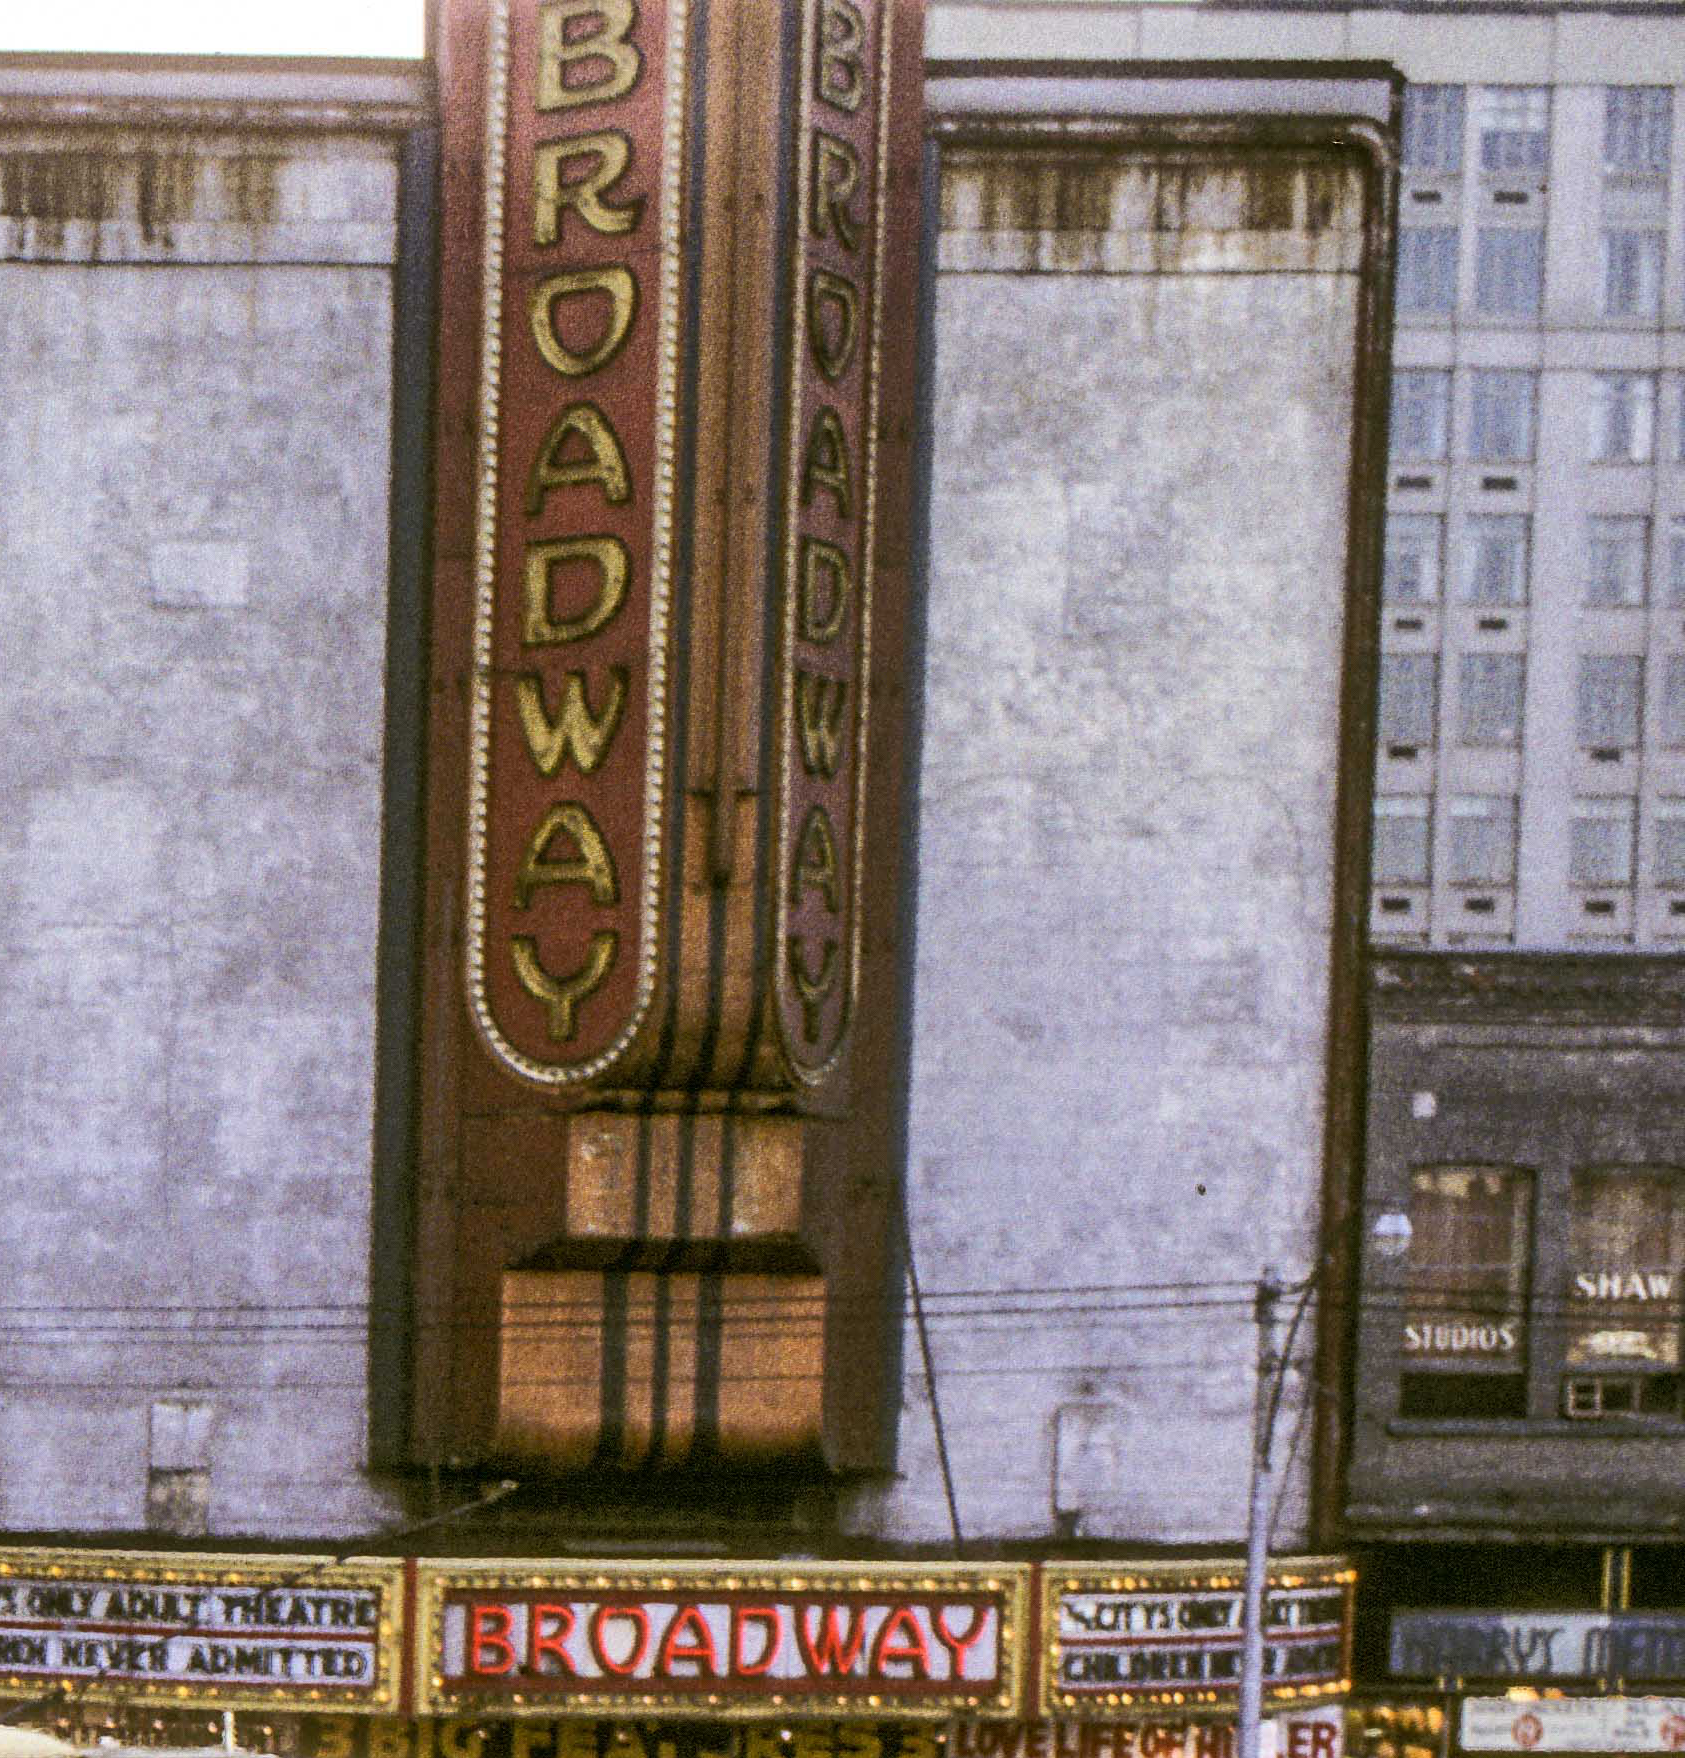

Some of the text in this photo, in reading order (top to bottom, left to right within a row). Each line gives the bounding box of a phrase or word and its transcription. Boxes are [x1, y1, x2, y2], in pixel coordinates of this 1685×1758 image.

[511, 0, 643, 1041] BROADWAY
[788, 0, 866, 1045] BROADWAY
[1575, 1273, 1673, 1299] SHAW
[1404, 1322, 1516, 1350] STUDIOS
[221, 1596, 376, 1627] THEATRE
[63, 1637, 168, 1670] NEVER
[187, 1644, 368, 1676] ADMITTED
[469, 1603, 988, 1677] BROADWAY
[957, 1722, 1050, 1758] LOVE
